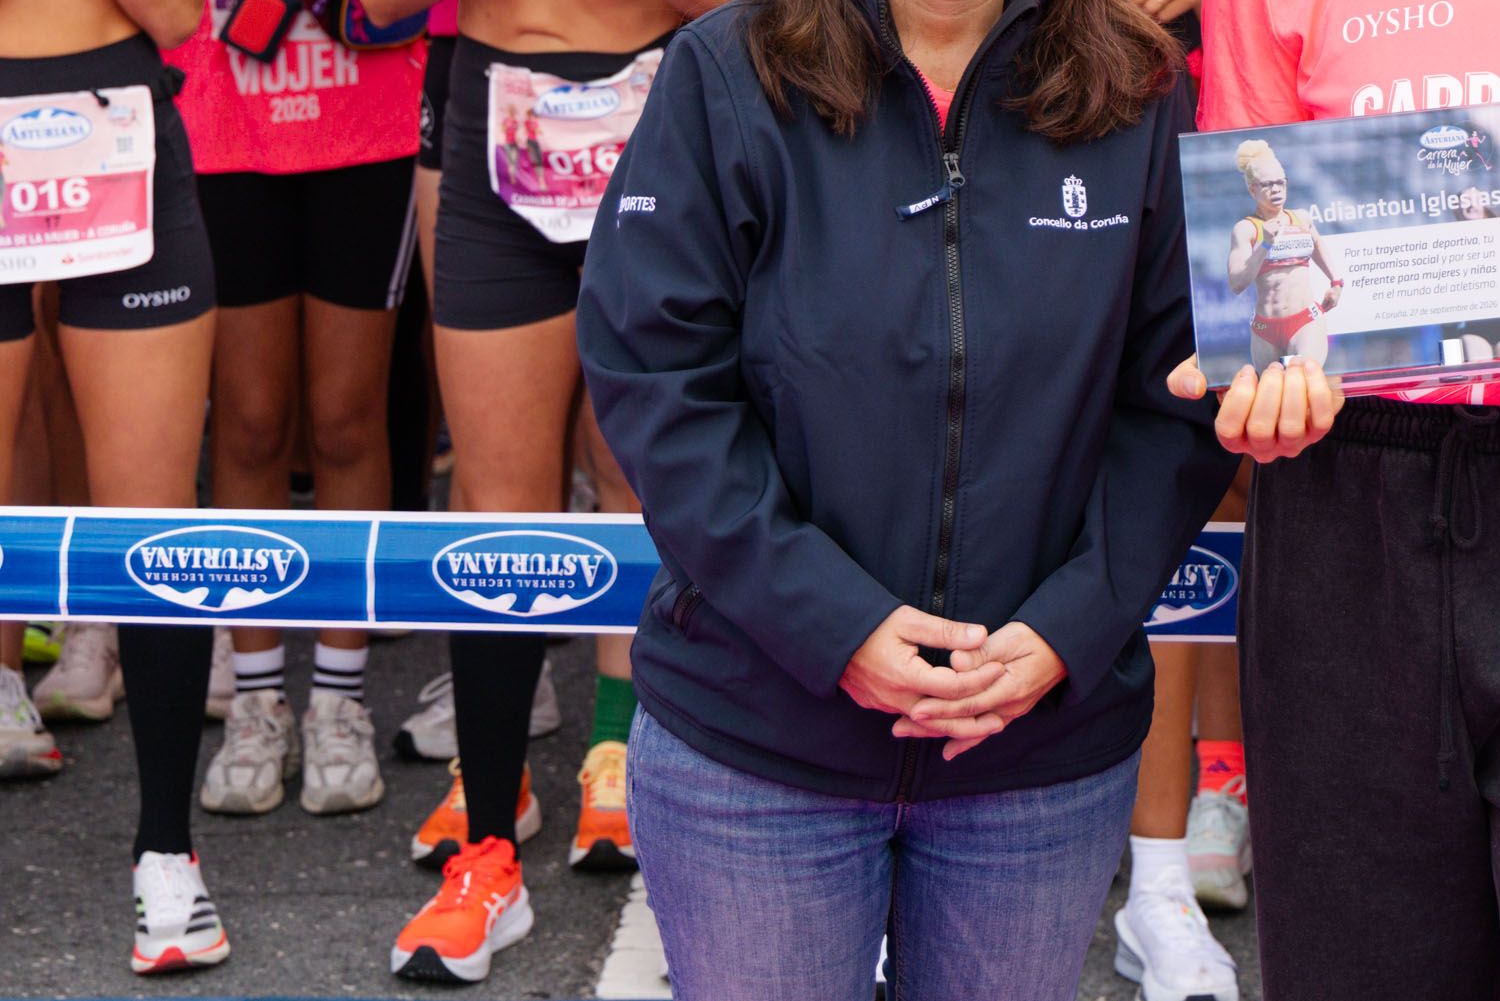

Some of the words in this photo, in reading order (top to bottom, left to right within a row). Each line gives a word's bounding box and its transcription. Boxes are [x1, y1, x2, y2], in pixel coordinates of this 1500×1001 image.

[1341, 0, 1455, 44] OYSHO
[8, 124, 85, 142] ASTURIANA
[1417, 148, 1458, 161] Carrera
[1441, 157, 1473, 176] Mujer
[10, 176, 91, 213] 016
[1029, 216, 1072, 229] Concello
[1074, 219, 1088, 230] da
[1090, 213, 1129, 229] Coruña
[1309, 198, 1415, 224] Adiaratou
[1345, 248, 1361, 258] Por
[1363, 246, 1373, 257] tu
[1376, 240, 1428, 256] trayectoria
[1483, 234, 1495, 245] tu
[1349, 258, 1409, 274] compromiso
[1411, 254, 1439, 267] social
[1449, 253, 1464, 264] por
[1466, 250, 1481, 261] ser
[1483, 249, 1496, 260] un
[1351, 274, 1395, 288] referente
[1397, 272, 1420, 285] para
[1422, 267, 1461, 282] mujeres
[1470, 263, 1498, 275] niñas
[122, 285, 191, 309] OYSHO
[1372, 290, 1385, 300] en
[1386, 288, 1396, 299] el
[1397, 284, 1432, 298] mundo
[1433, 282, 1449, 295] del
[1450, 279, 1497, 294] atletismo
[140, 546, 297, 582] ASTURIANA
[447, 552, 605, 588] ASTURIANA
[145, 571, 204, 582] LECHERA
[209, 573, 268, 583] CENTRAL
[453, 577, 512, 588] LECHERA
[517, 578, 576, 589] CENTRAL
